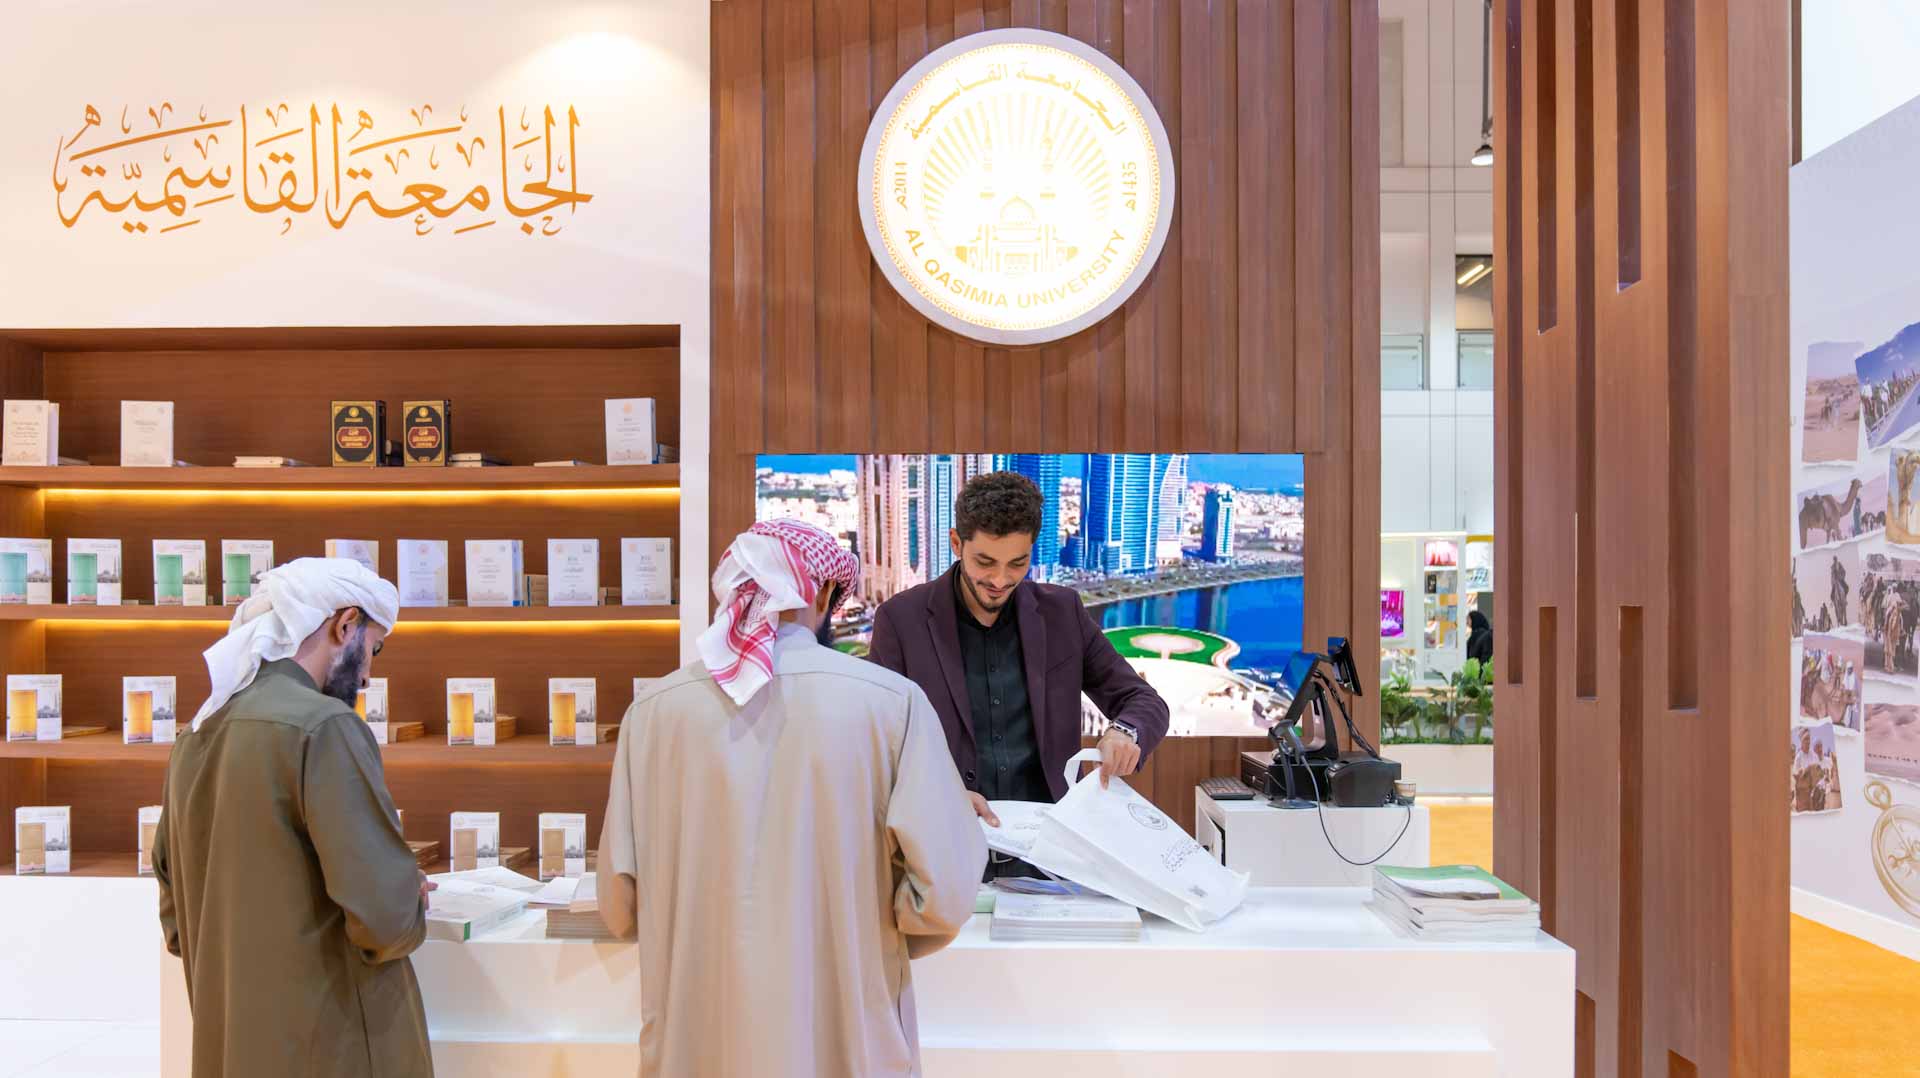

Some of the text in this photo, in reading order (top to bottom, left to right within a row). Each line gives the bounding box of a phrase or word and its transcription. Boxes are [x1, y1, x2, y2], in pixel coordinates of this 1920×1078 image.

[904, 228, 1126, 309] AL QASIMIA UNIVERSITY
